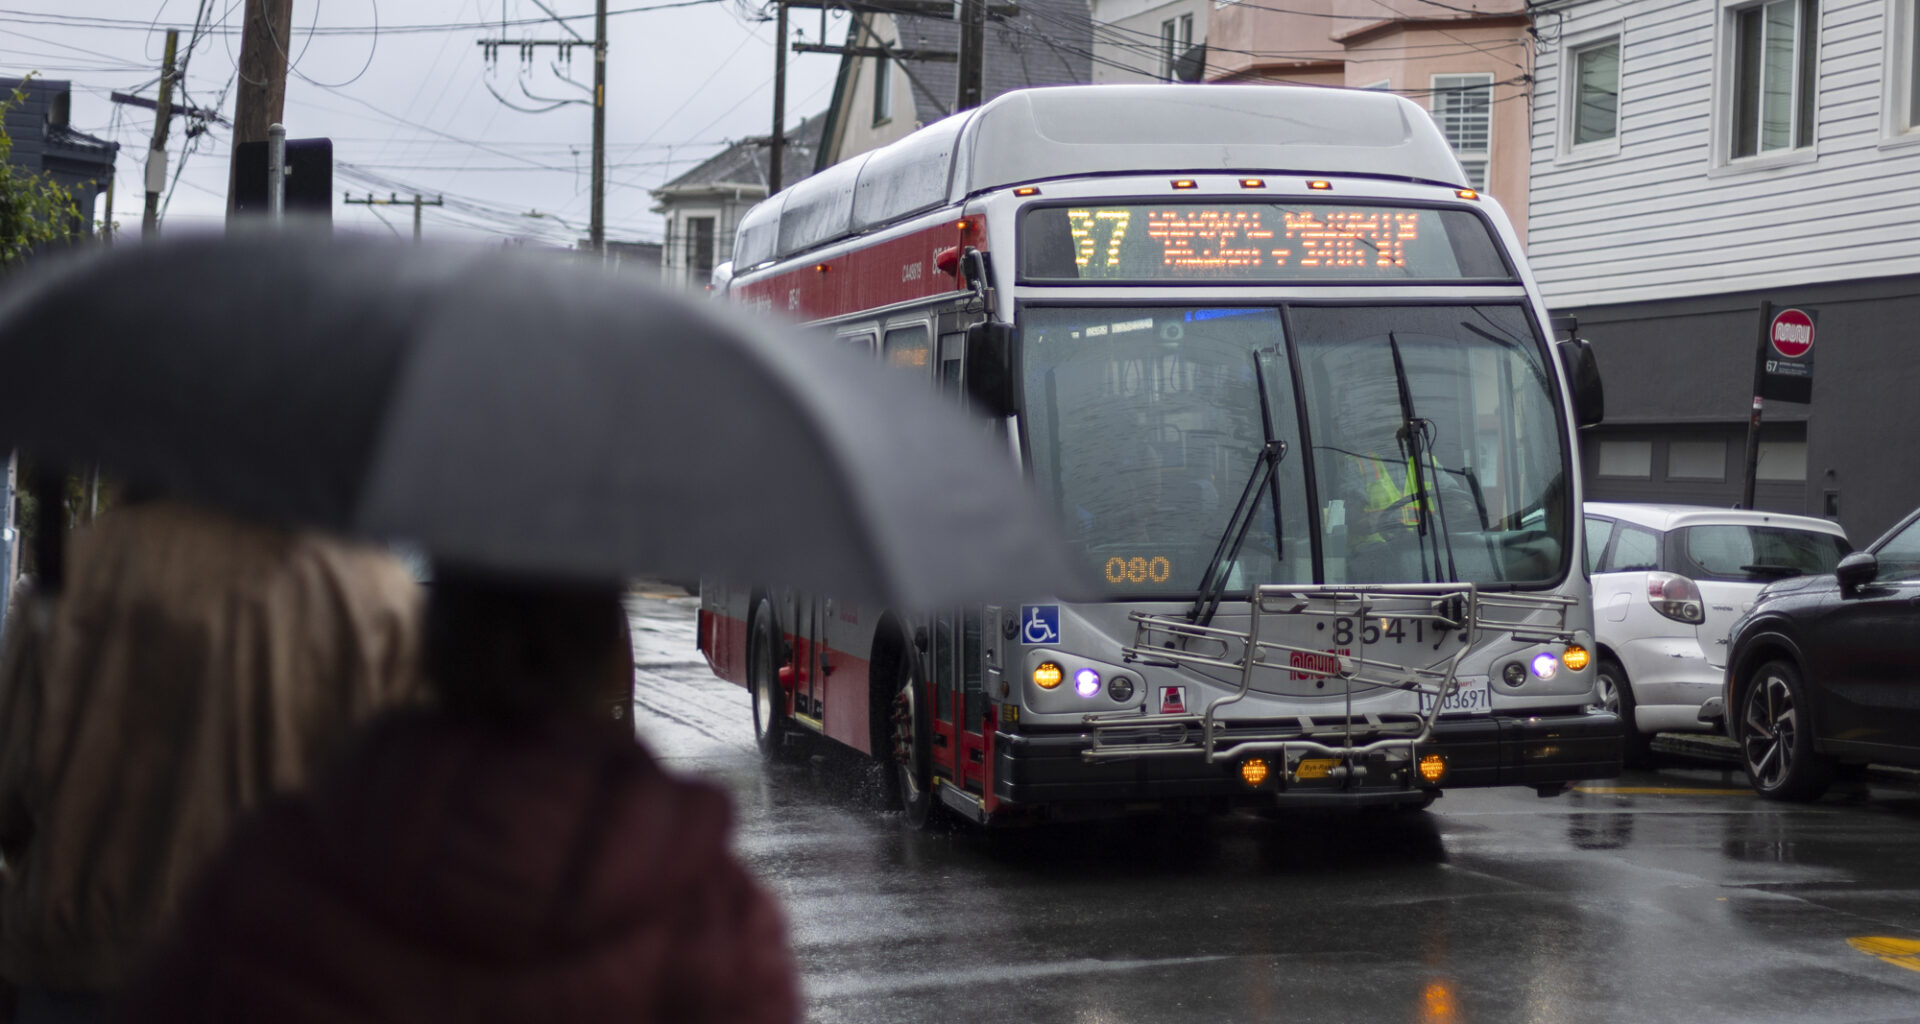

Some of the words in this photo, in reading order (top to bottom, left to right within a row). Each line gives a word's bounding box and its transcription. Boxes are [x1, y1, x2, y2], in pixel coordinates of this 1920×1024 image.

[1766, 360, 1778, 372] 67
[1106, 556, 1169, 583] 080
[1425, 689, 1486, 711] 103697
